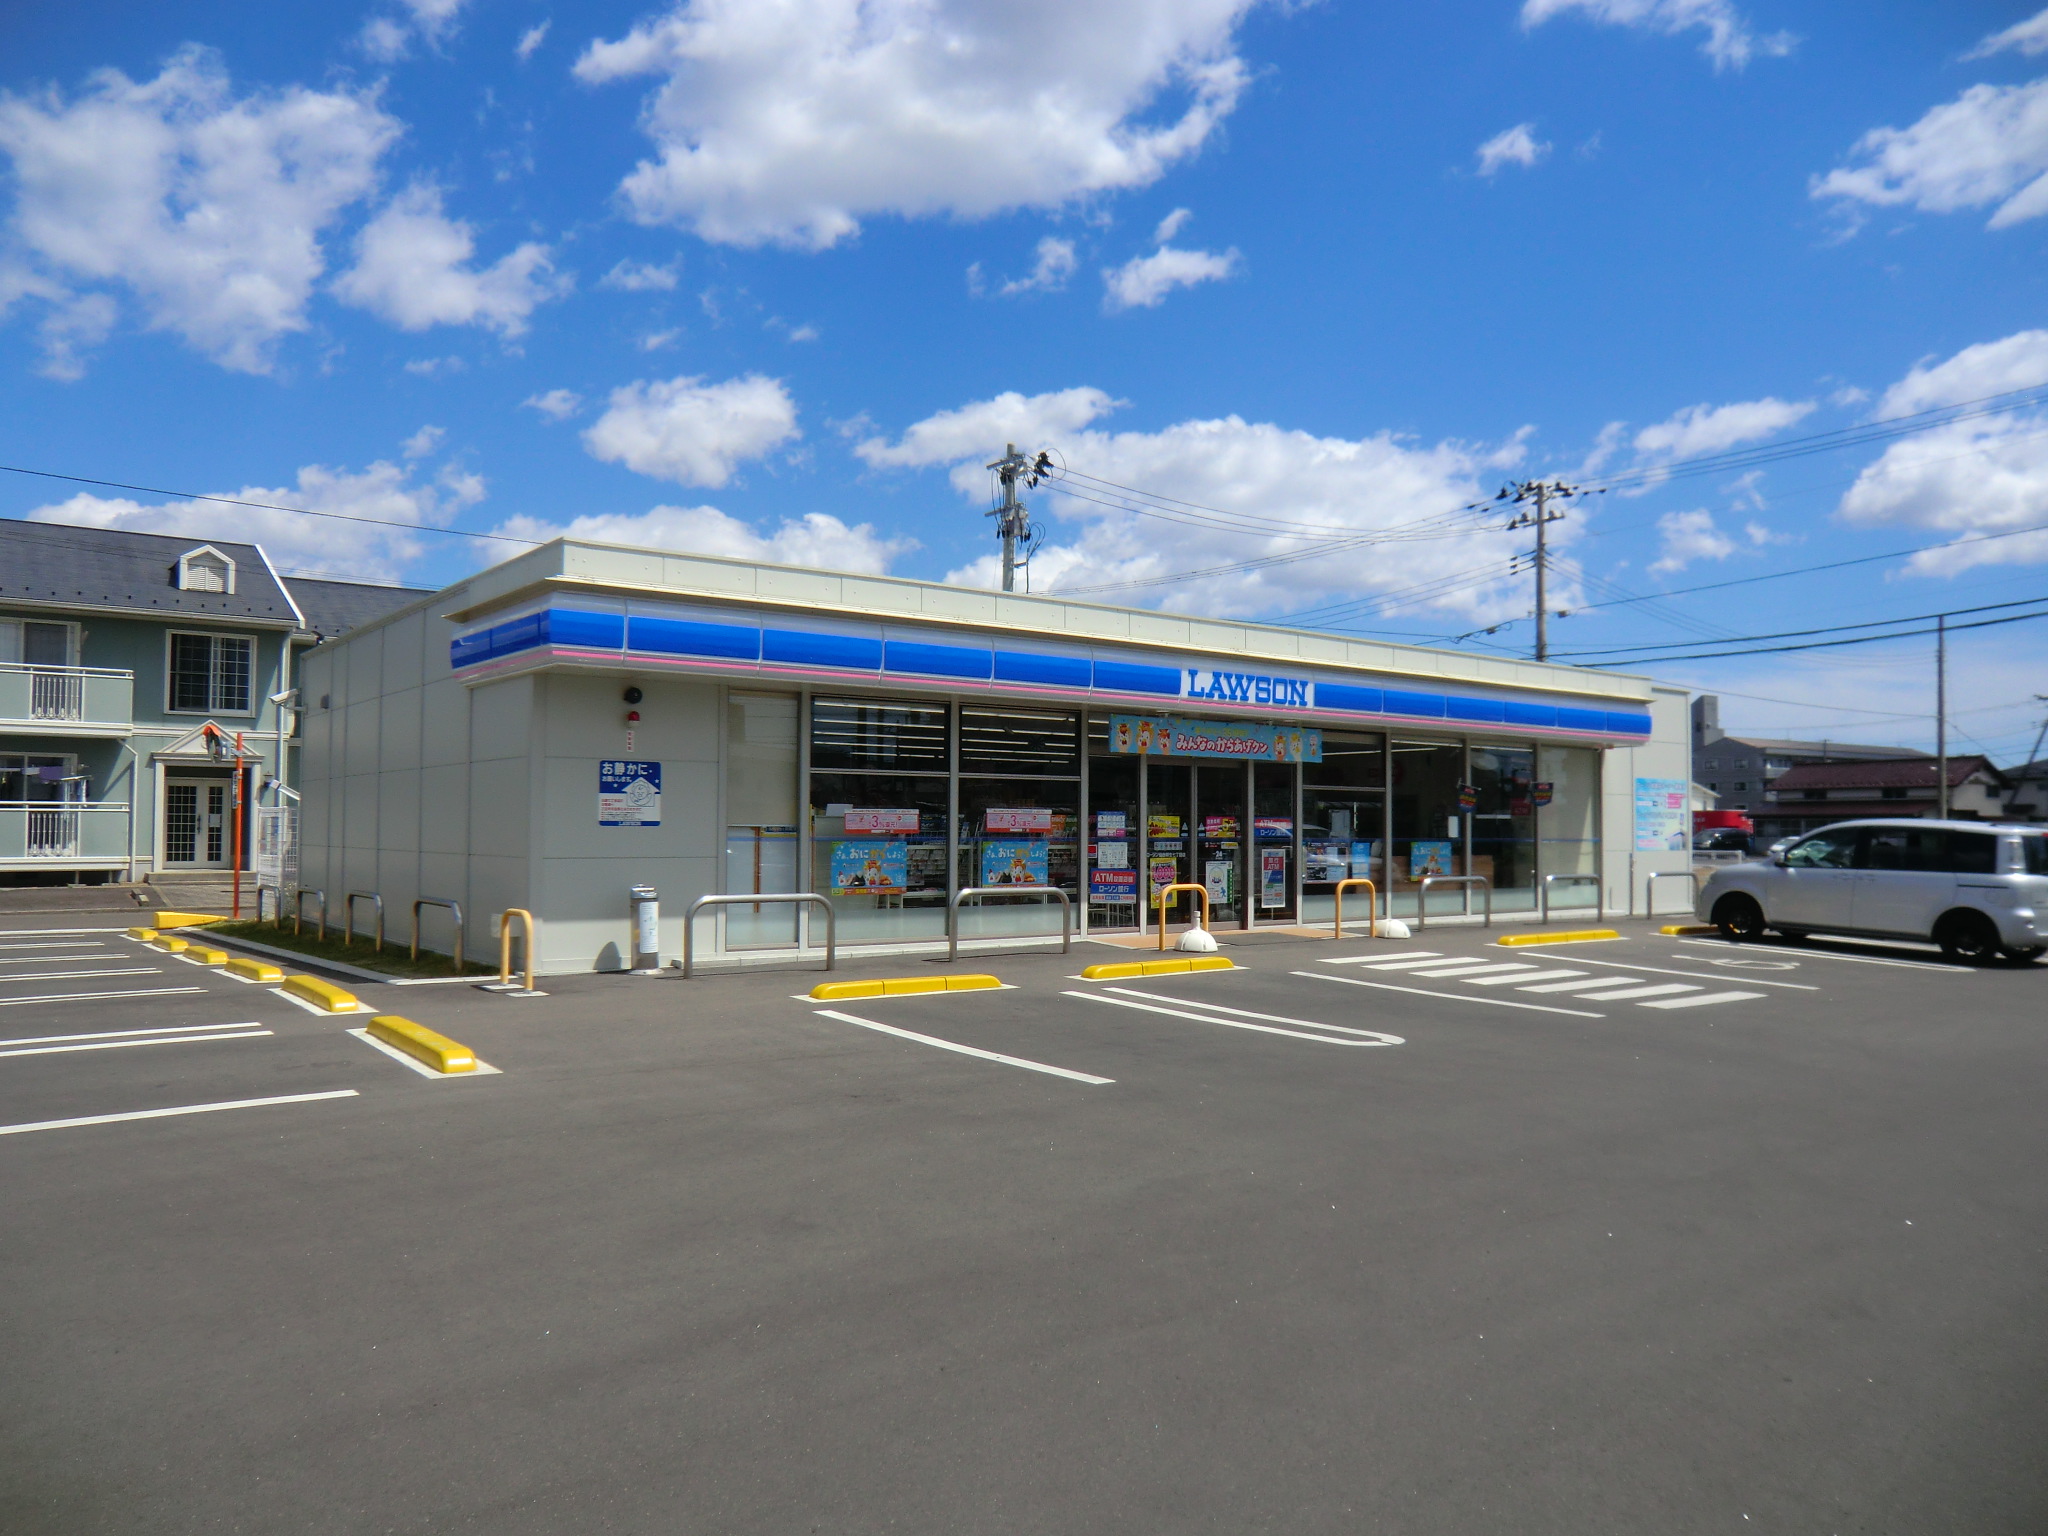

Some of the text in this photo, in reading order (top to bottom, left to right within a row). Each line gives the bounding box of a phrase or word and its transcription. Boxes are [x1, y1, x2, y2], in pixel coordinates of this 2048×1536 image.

[1187, 669, 1309, 706] LAWSON
[1176, 733, 1268, 754] みんなのからあげクン
